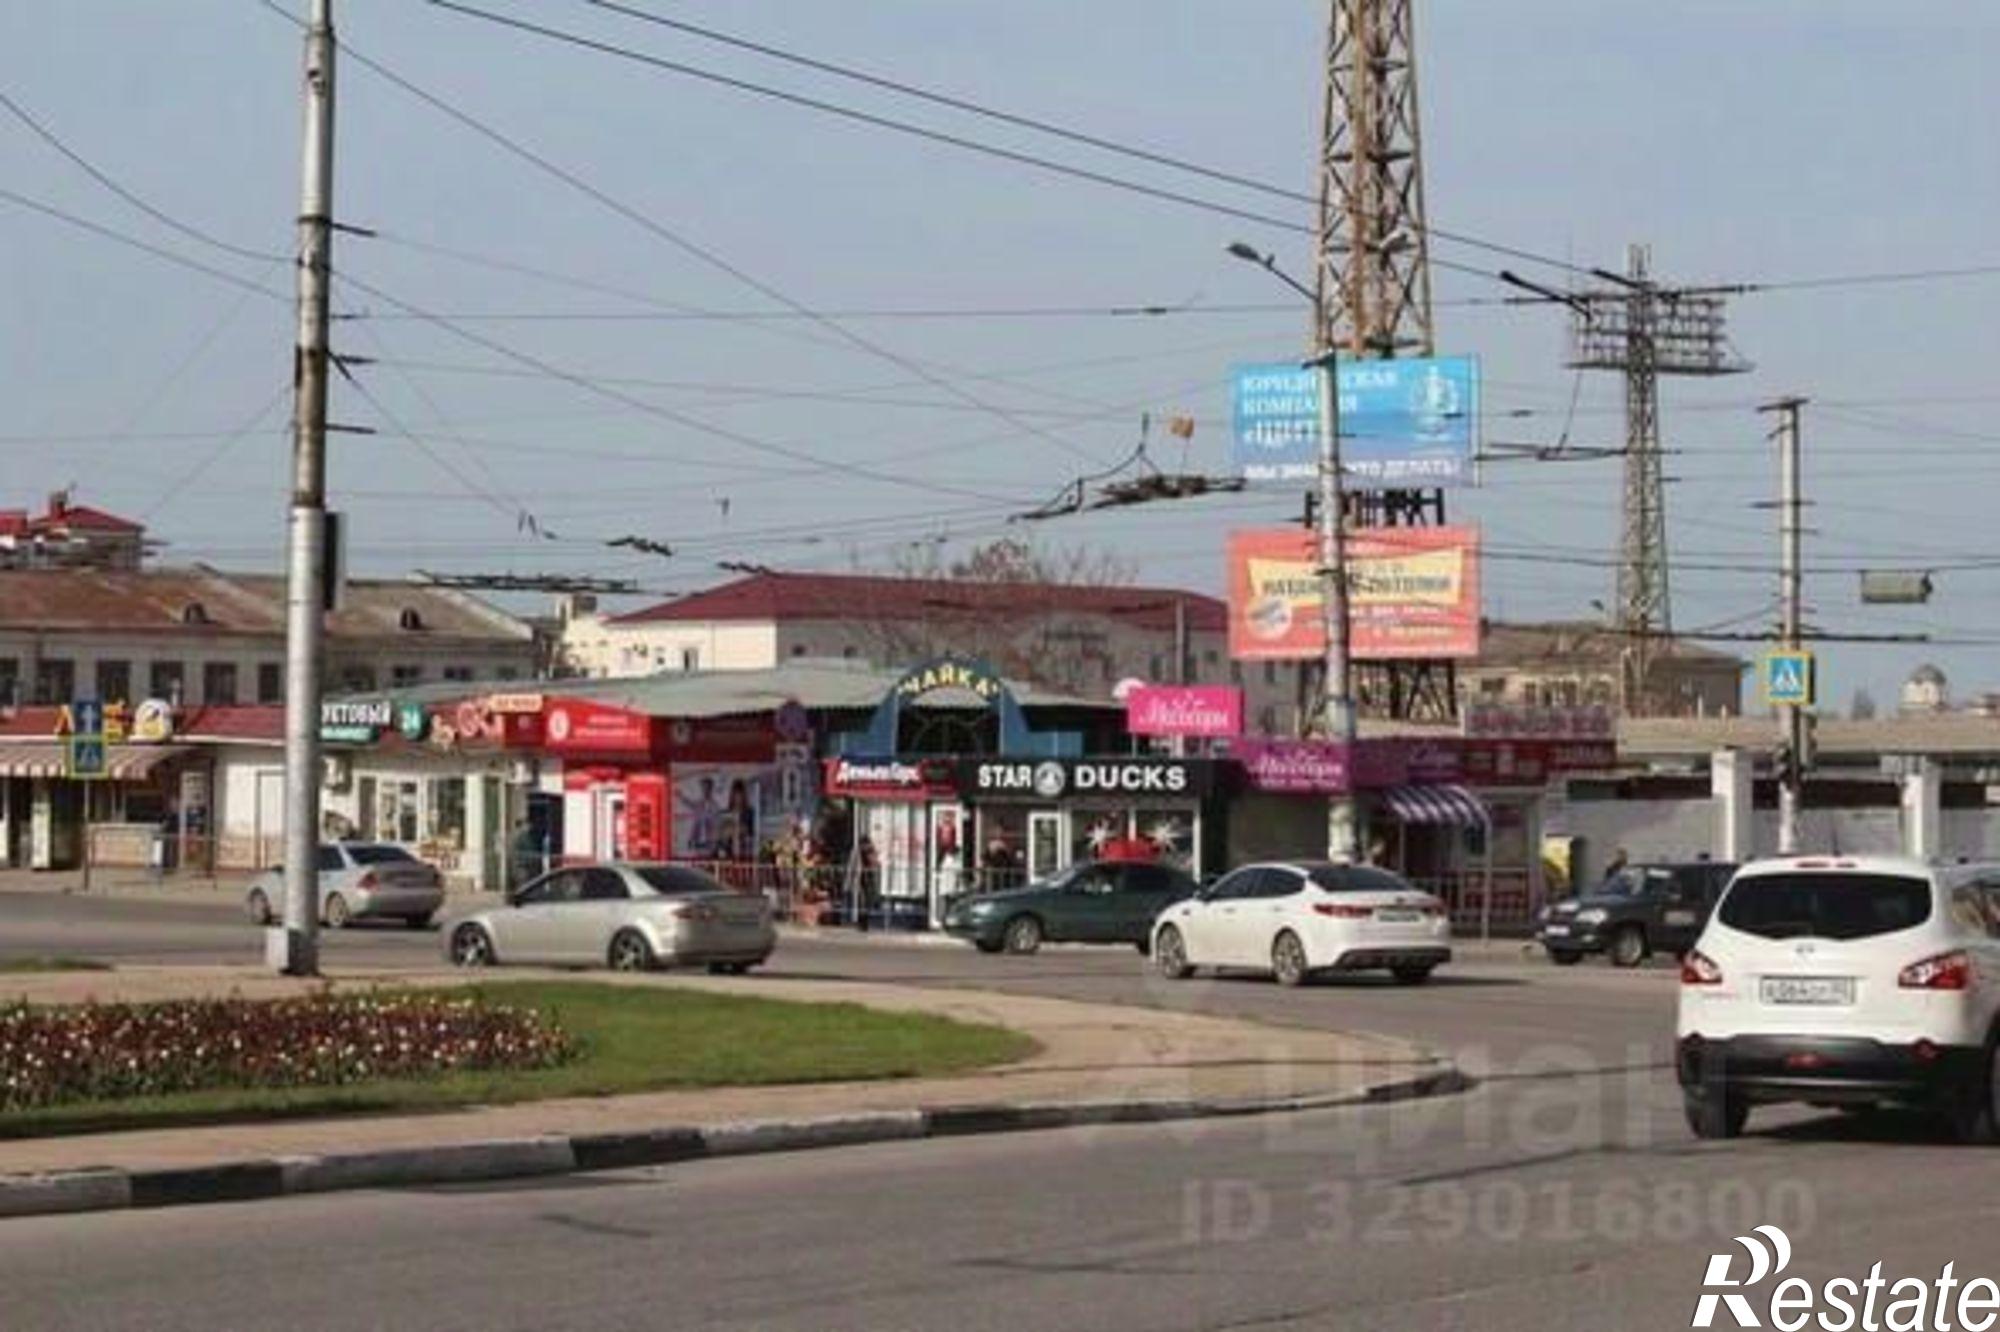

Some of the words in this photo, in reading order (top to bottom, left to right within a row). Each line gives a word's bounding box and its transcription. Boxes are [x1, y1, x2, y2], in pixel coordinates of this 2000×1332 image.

[1243, 372, 1397, 392] ЮРИДИСКАЯ
[1243, 394, 1357, 415] КОМПАЯ
[978, 765, 1032, 788] STAR
[1075, 764, 1186, 790] DUCKS
